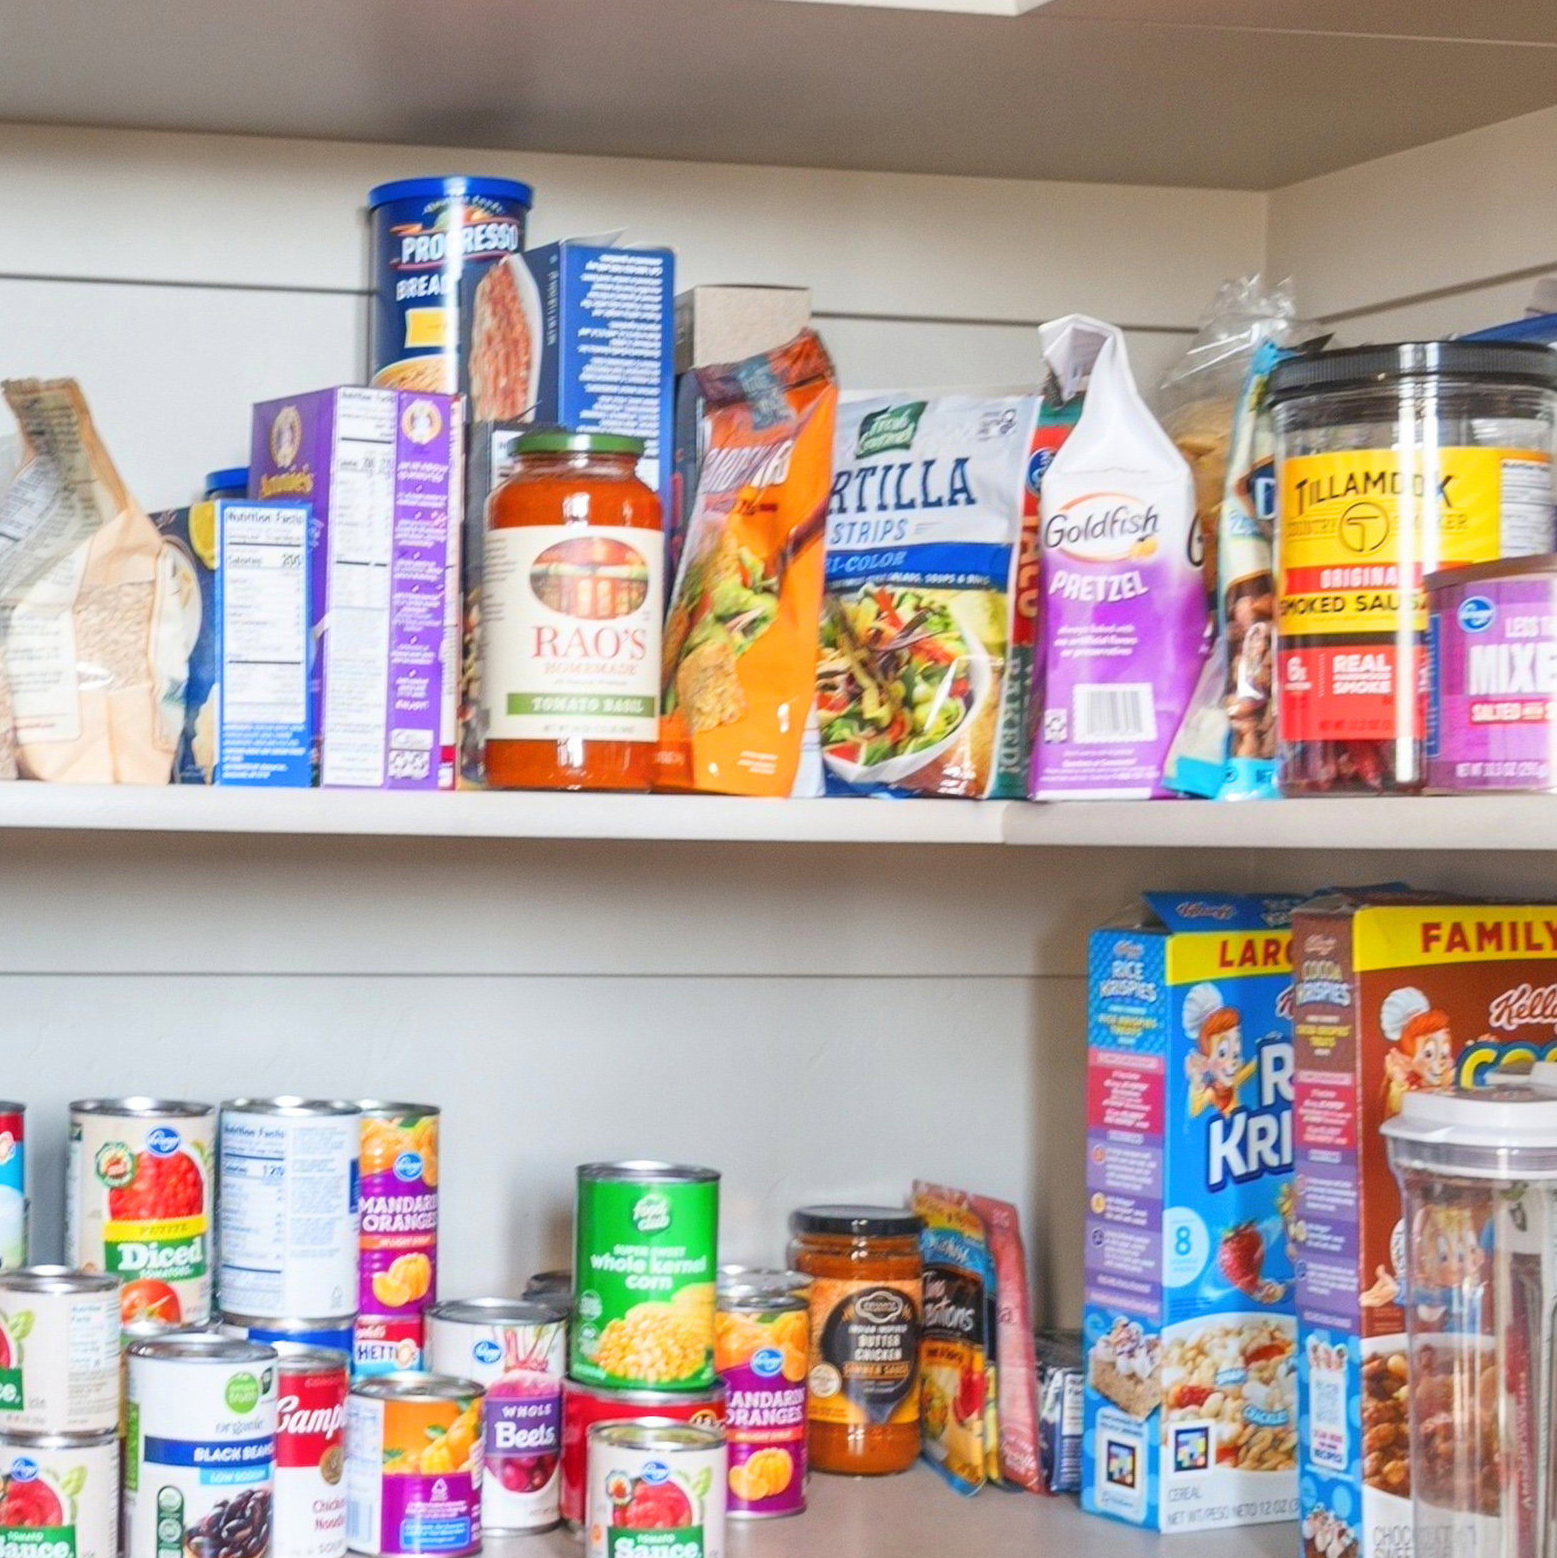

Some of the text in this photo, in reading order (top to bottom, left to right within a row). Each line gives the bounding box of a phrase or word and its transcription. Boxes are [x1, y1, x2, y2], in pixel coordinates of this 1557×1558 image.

[401, 224, 518, 264] PROGRESSO
[830, 518, 909, 545] STRIPS
[1045, 506, 1159, 549] Goldfish
[1048, 569, 1148, 603] PRETZEL
[532, 626, 646, 660] RAO'S
[1332, 655, 1391, 673] REAL
[1332, 679, 1390, 695] SMOKE
[532, 697, 645, 713] TOMATO BASIL
[1471, 702, 1521, 721] SALTED
[1112, 963, 1145, 982] RICE
[1099, 980, 1158, 1003] KRISPIES
[633, 1202, 665, 1220] food
[362, 1212, 437, 1232] ORANGES
[637, 1217, 670, 1231] club
[1174, 1226, 1192, 1255] 8
[117, 1238, 203, 1270] Diced
[590, 1252, 707, 1274] whole kernel
[625, 1273, 673, 1291] corn
[501, 1404, 553, 1420] WHOLE
[494, 1420, 557, 1450] Beets
[194, 1446, 239, 1463] BLACK
[1167, 1486, 1202, 1503] CEREAL
